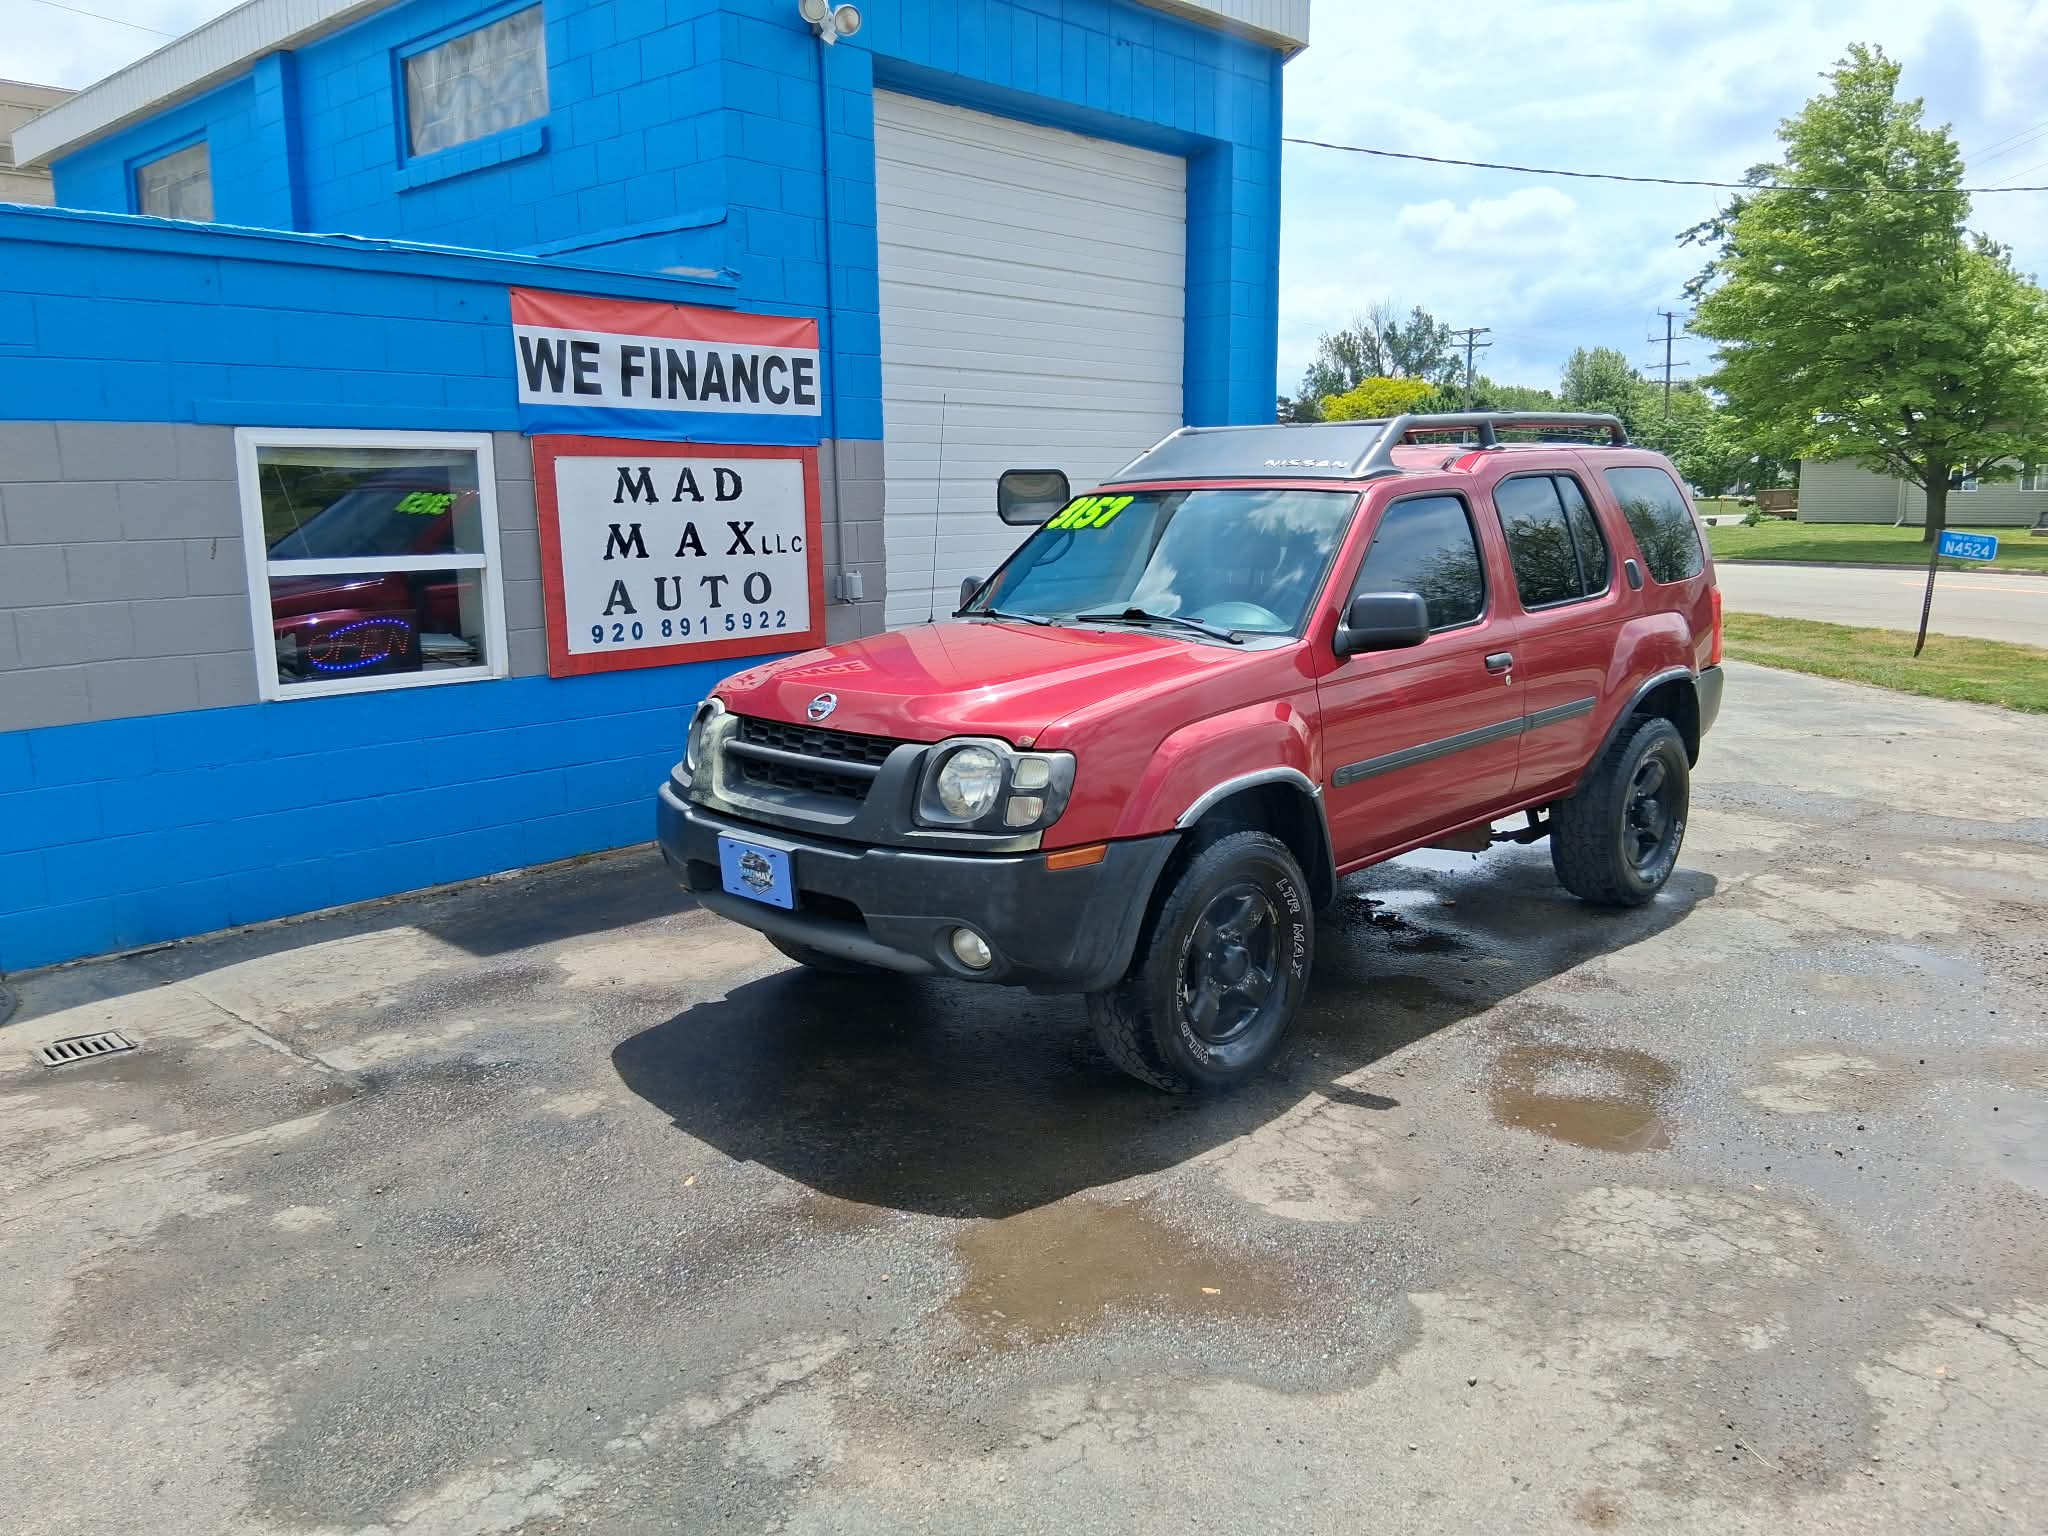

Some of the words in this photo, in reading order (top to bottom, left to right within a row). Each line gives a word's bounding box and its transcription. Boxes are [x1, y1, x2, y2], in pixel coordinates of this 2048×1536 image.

[518, 336, 602, 395] WE
[620, 344, 816, 406] FINANCE
[1263, 459, 1349, 468] NISSAN
[613, 466, 743, 504] MAD
[603, 521, 756, 560] MAX
[761, 533, 803, 555] LLC
[1945, 541, 1989, 557] N4524
[603, 571, 772, 616] AUTO
[591, 620, 644, 644] 920
[661, 616, 708, 637] 891
[725, 609, 787, 632] 5922
[309, 628, 409, 662] OPEN
[1276, 878, 1301, 914] LTR
